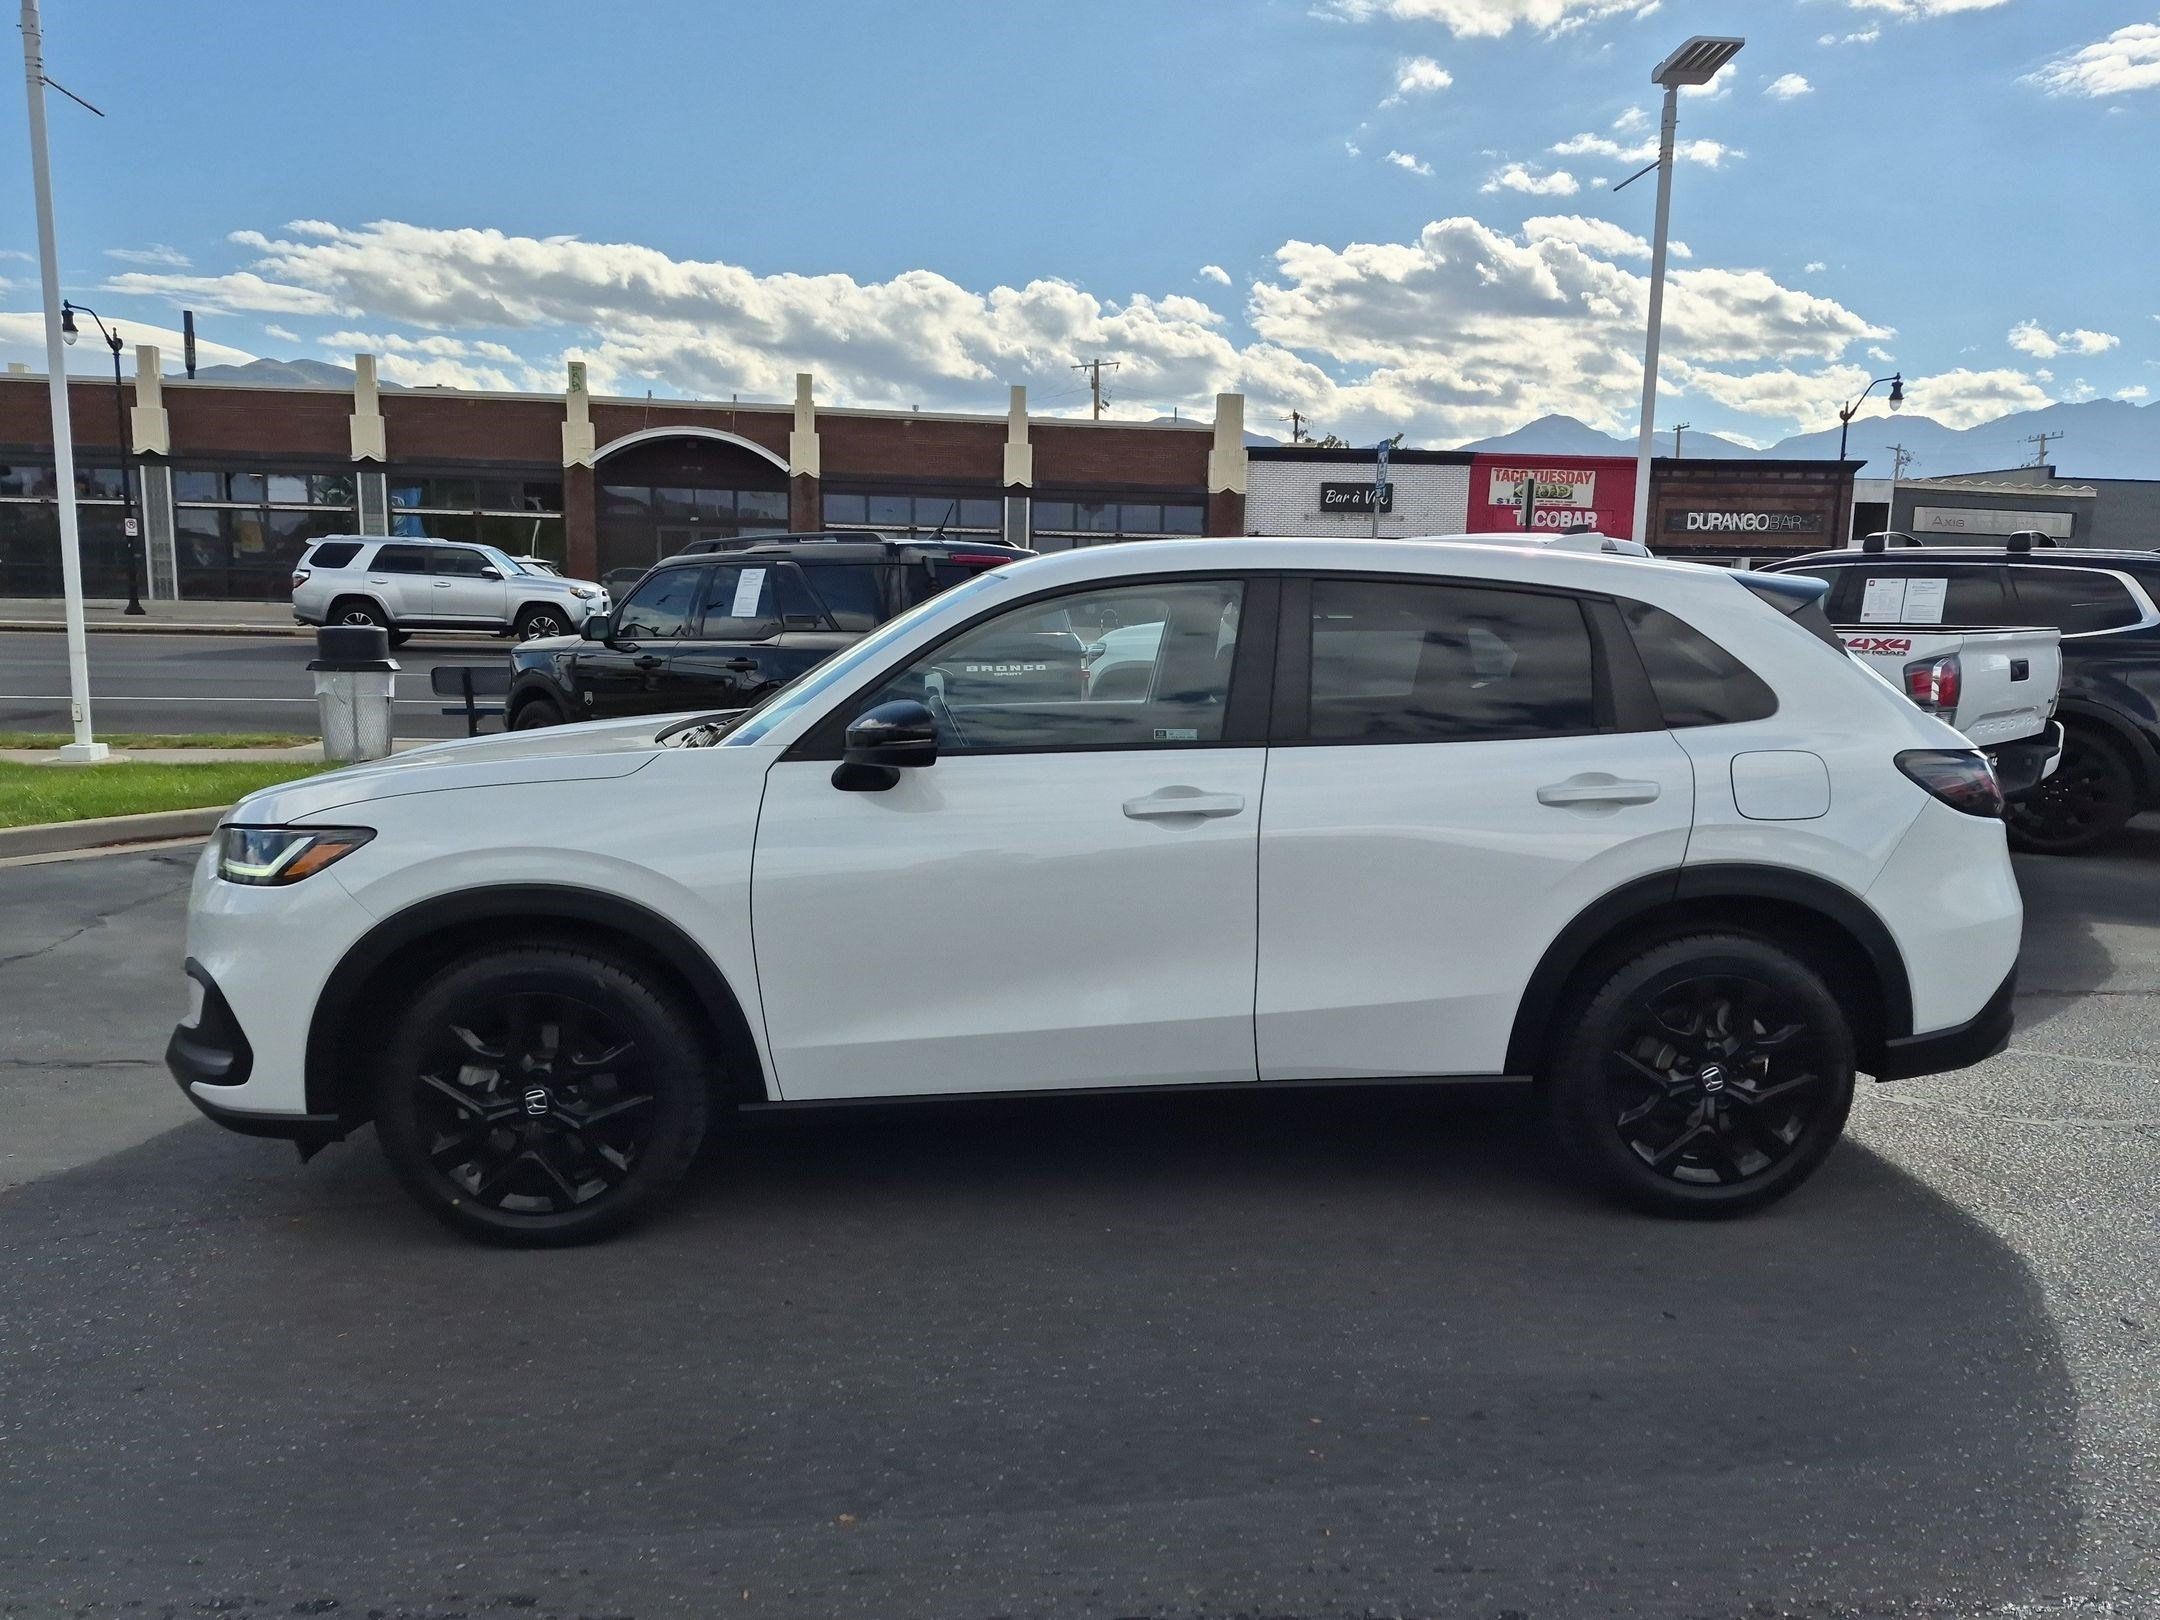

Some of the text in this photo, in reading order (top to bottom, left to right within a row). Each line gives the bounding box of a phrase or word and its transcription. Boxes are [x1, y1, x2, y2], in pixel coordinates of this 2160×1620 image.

[1494, 469, 1593, 485] TACO TUESDAY
[1325, 489, 1350, 504] Bar
[1352, 490, 1360, 504] à
[1513, 510, 1597, 529] TCOBAR
[966, 664, 1046, 672] BRONCO
